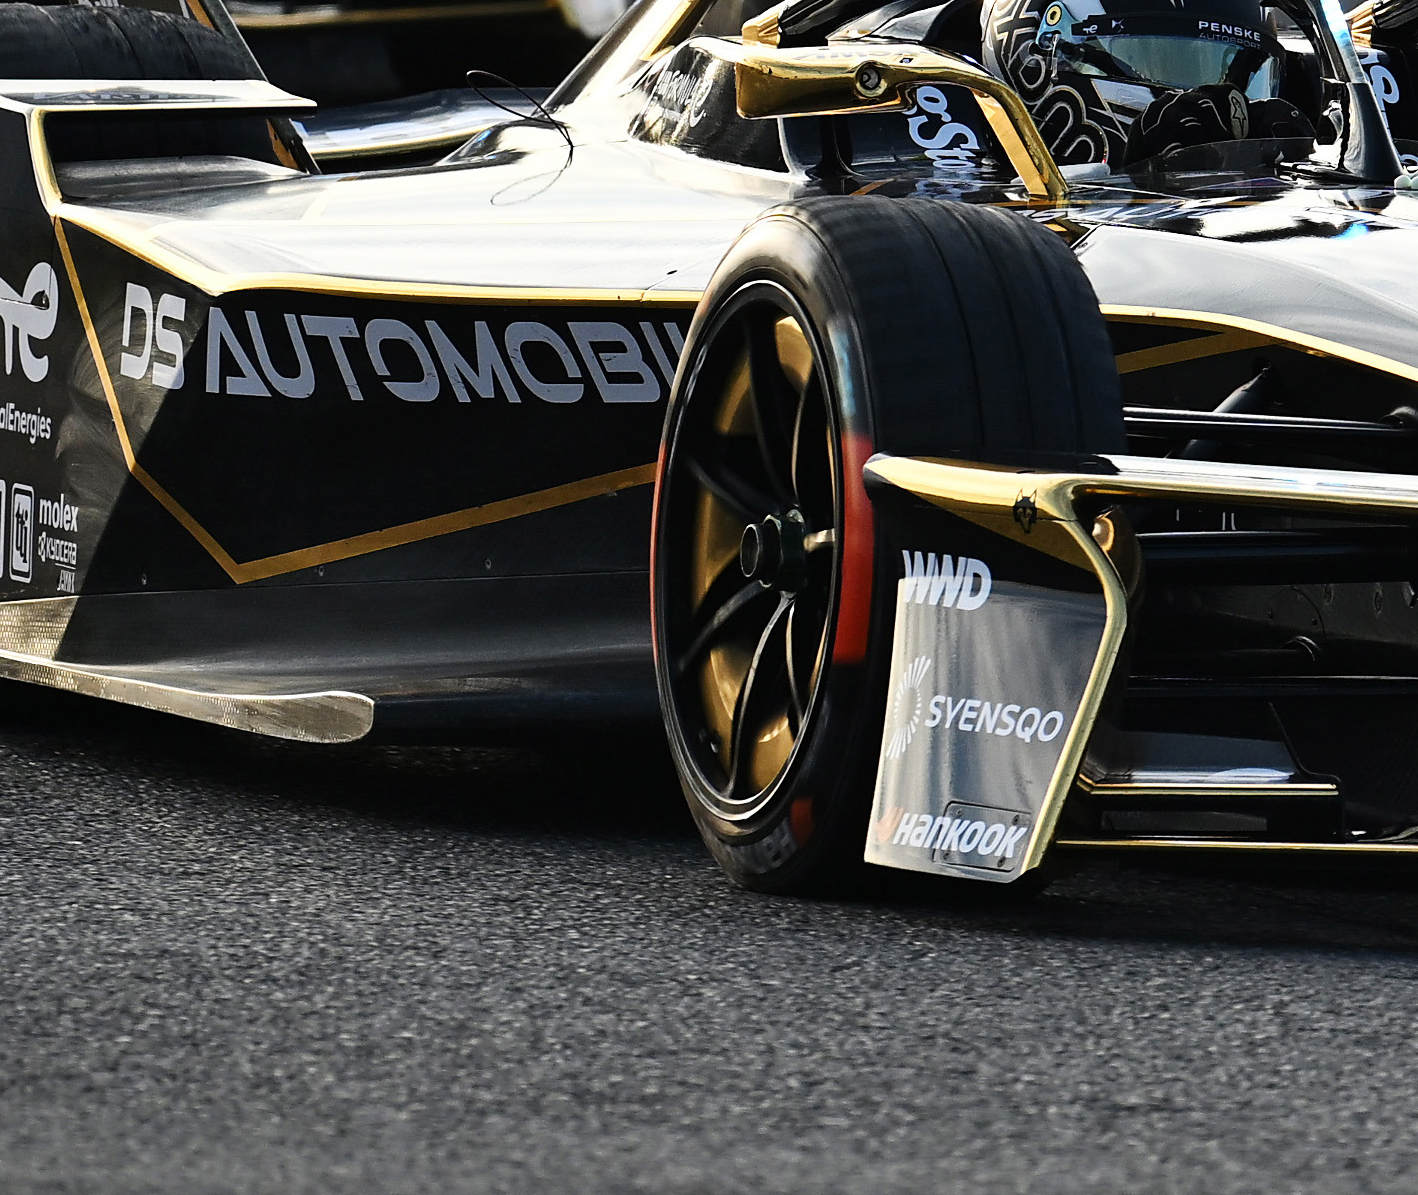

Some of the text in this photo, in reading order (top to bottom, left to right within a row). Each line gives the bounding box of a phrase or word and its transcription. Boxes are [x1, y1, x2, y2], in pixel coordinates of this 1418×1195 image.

[1198, 20, 1262, 42] PENSKE
[1199, 32, 1261, 50] AUTOSPORT
[120, 282, 186, 390] DS
[39, 493, 79, 533] molex
[46, 537, 77, 565] KYOCERA
[902, 549, 992, 611] WWD
[924, 695, 1065, 743] SYENSQO
